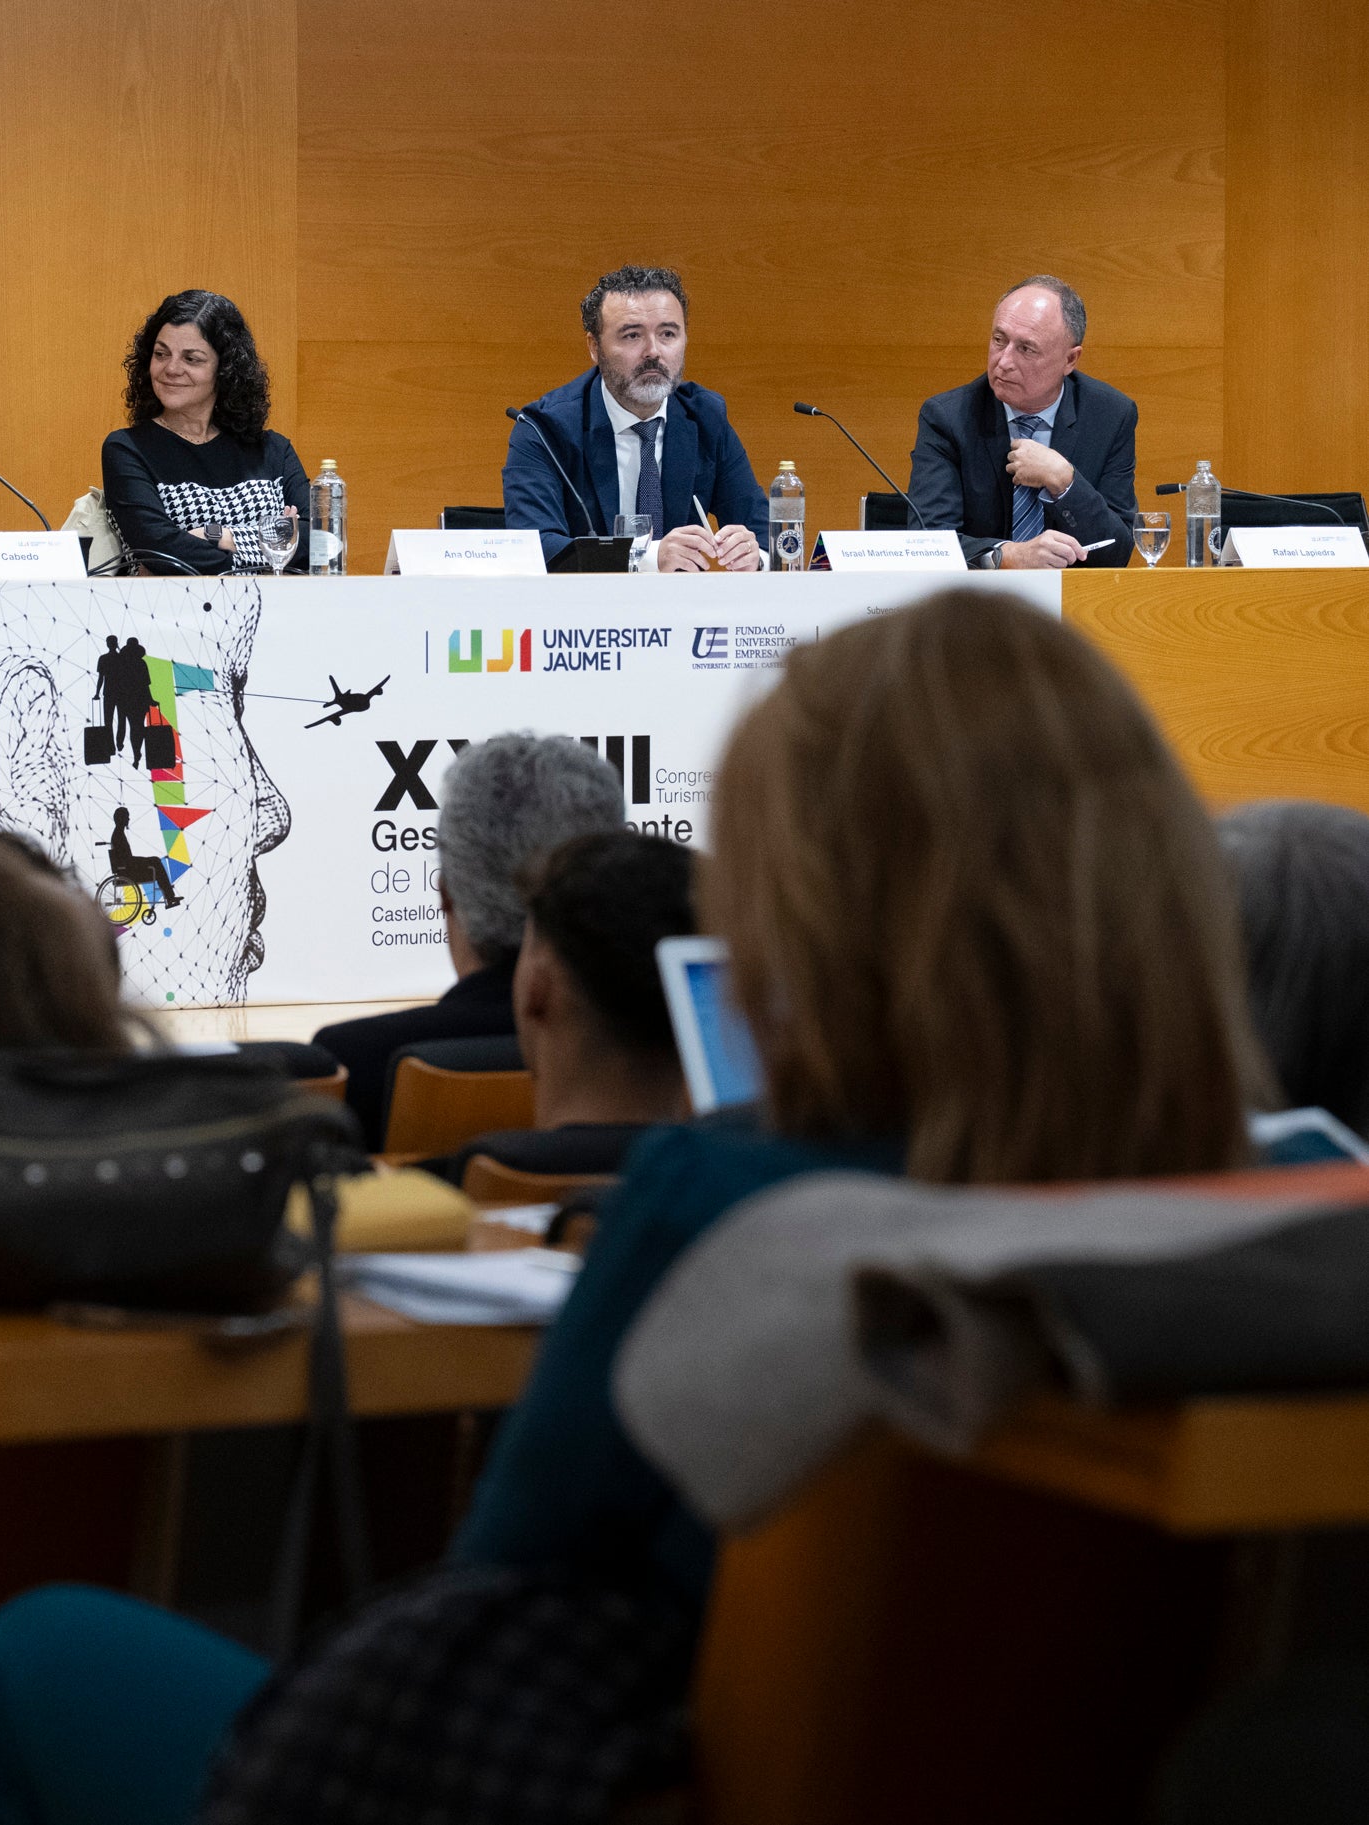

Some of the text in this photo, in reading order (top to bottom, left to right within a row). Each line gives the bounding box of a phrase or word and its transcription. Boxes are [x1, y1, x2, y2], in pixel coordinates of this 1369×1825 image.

[1, 552, 39, 561] Cabedo
[444, 549, 497, 560] Ana Olucha
[841, 549, 866, 558] Israel
[1272, 548, 1335, 561] Rafael Lapiedra
[734, 624, 785, 636] FUNDACIÓ
[542, 627, 672, 649] UNIVERSITAT
[734, 636, 797, 648] UNIVERSITAT
[734, 648, 780, 659] EMPRESA
[542, 651, 622, 672] JAUME I
[371, 862, 411, 893] de
[371, 904, 446, 923] Castellón
